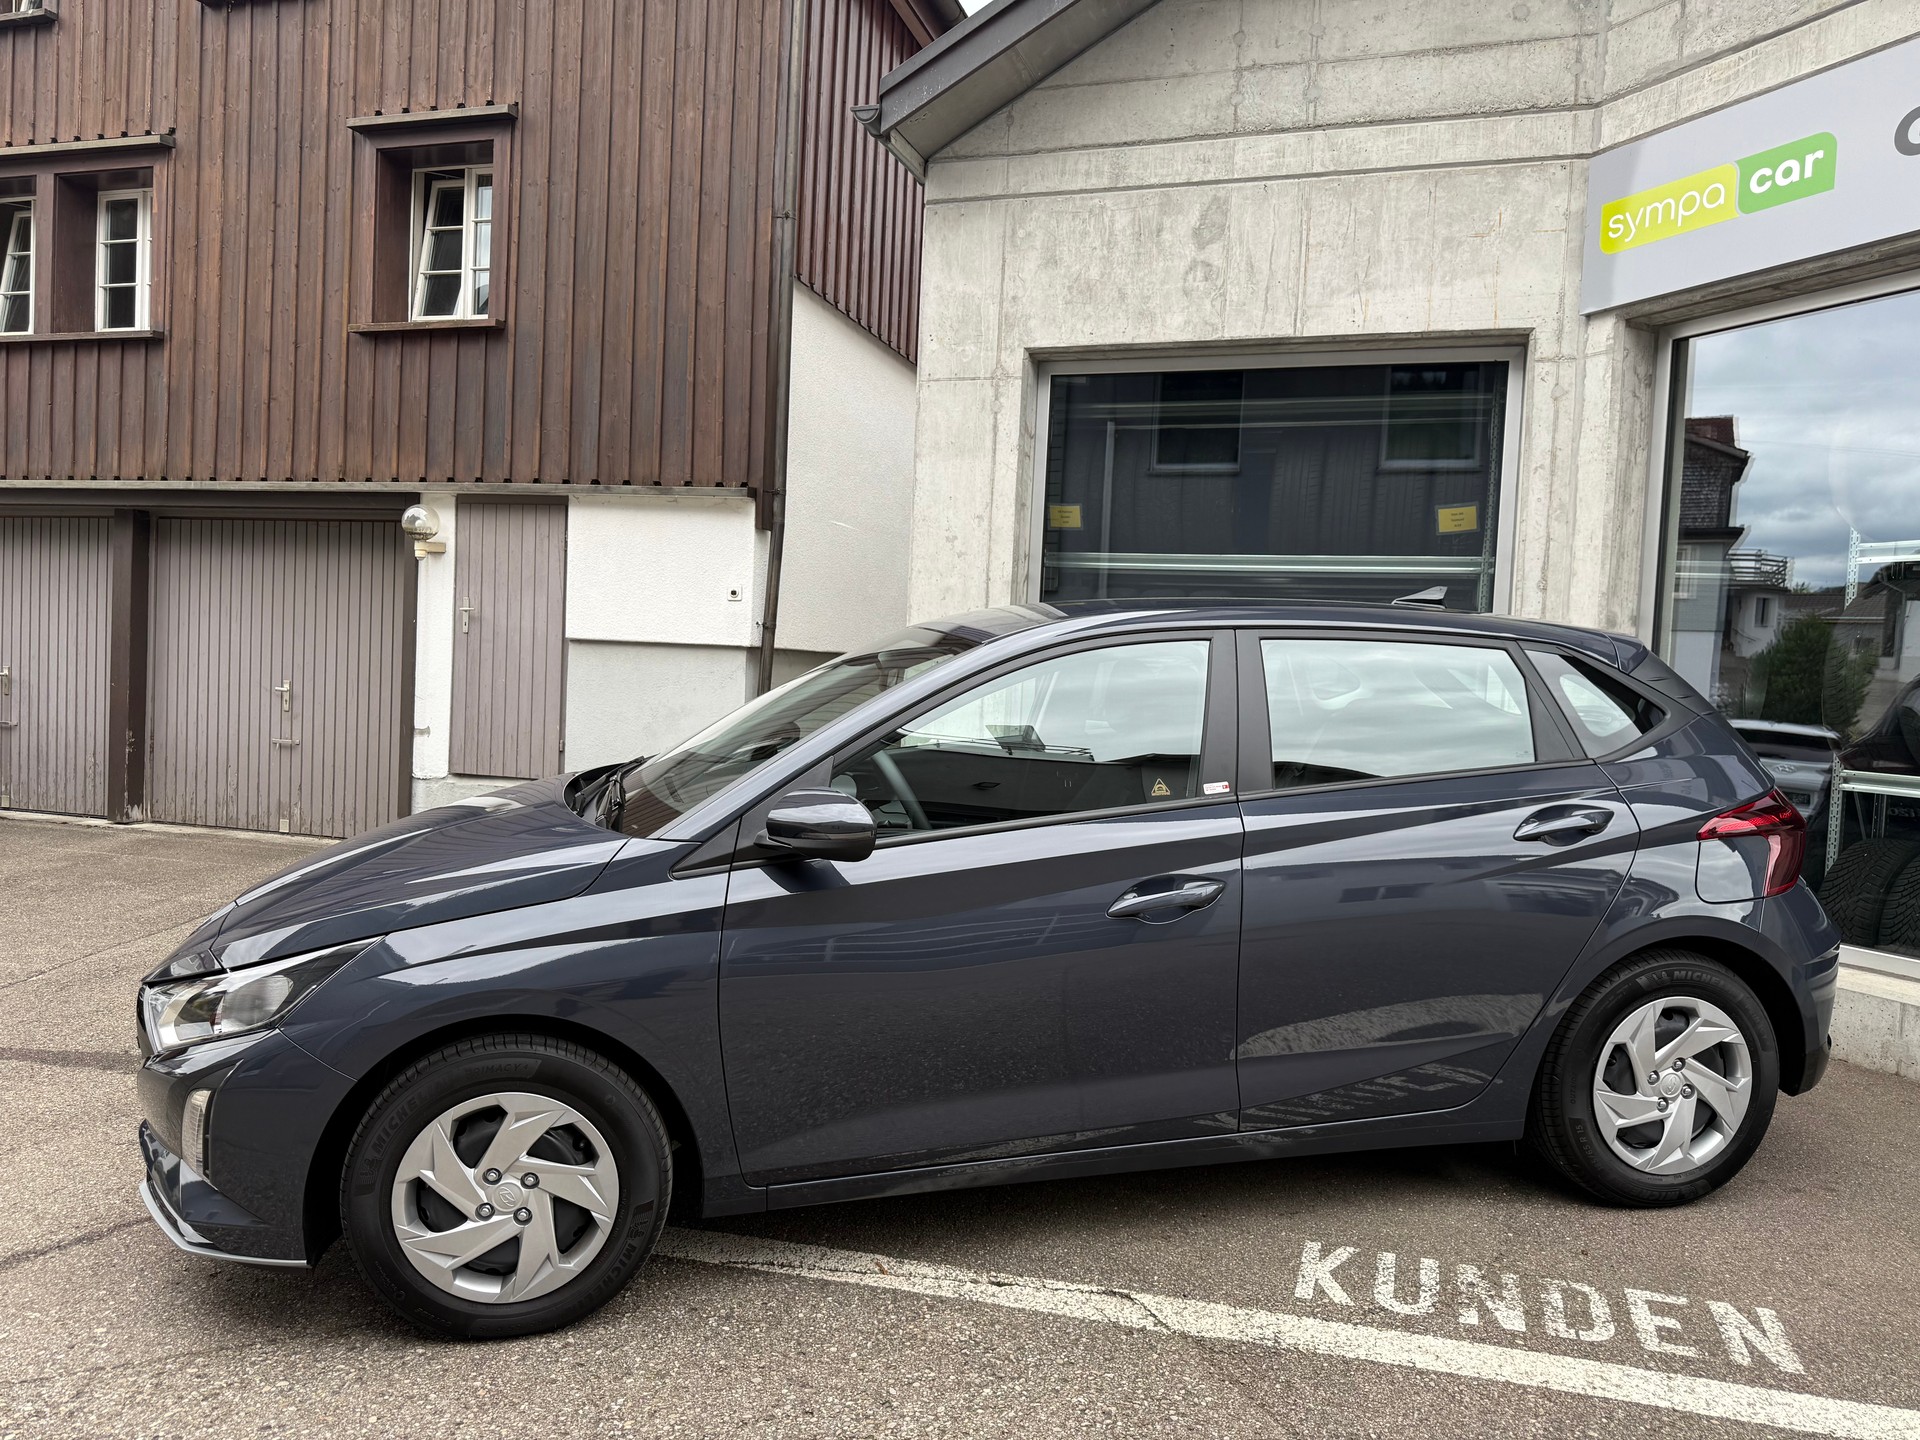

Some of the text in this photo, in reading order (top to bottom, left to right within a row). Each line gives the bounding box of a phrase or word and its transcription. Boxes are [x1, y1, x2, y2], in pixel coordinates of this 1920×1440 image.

[1608, 148, 1824, 242] sympa car
[1294, 1240, 1804, 1375] KUNDEN
